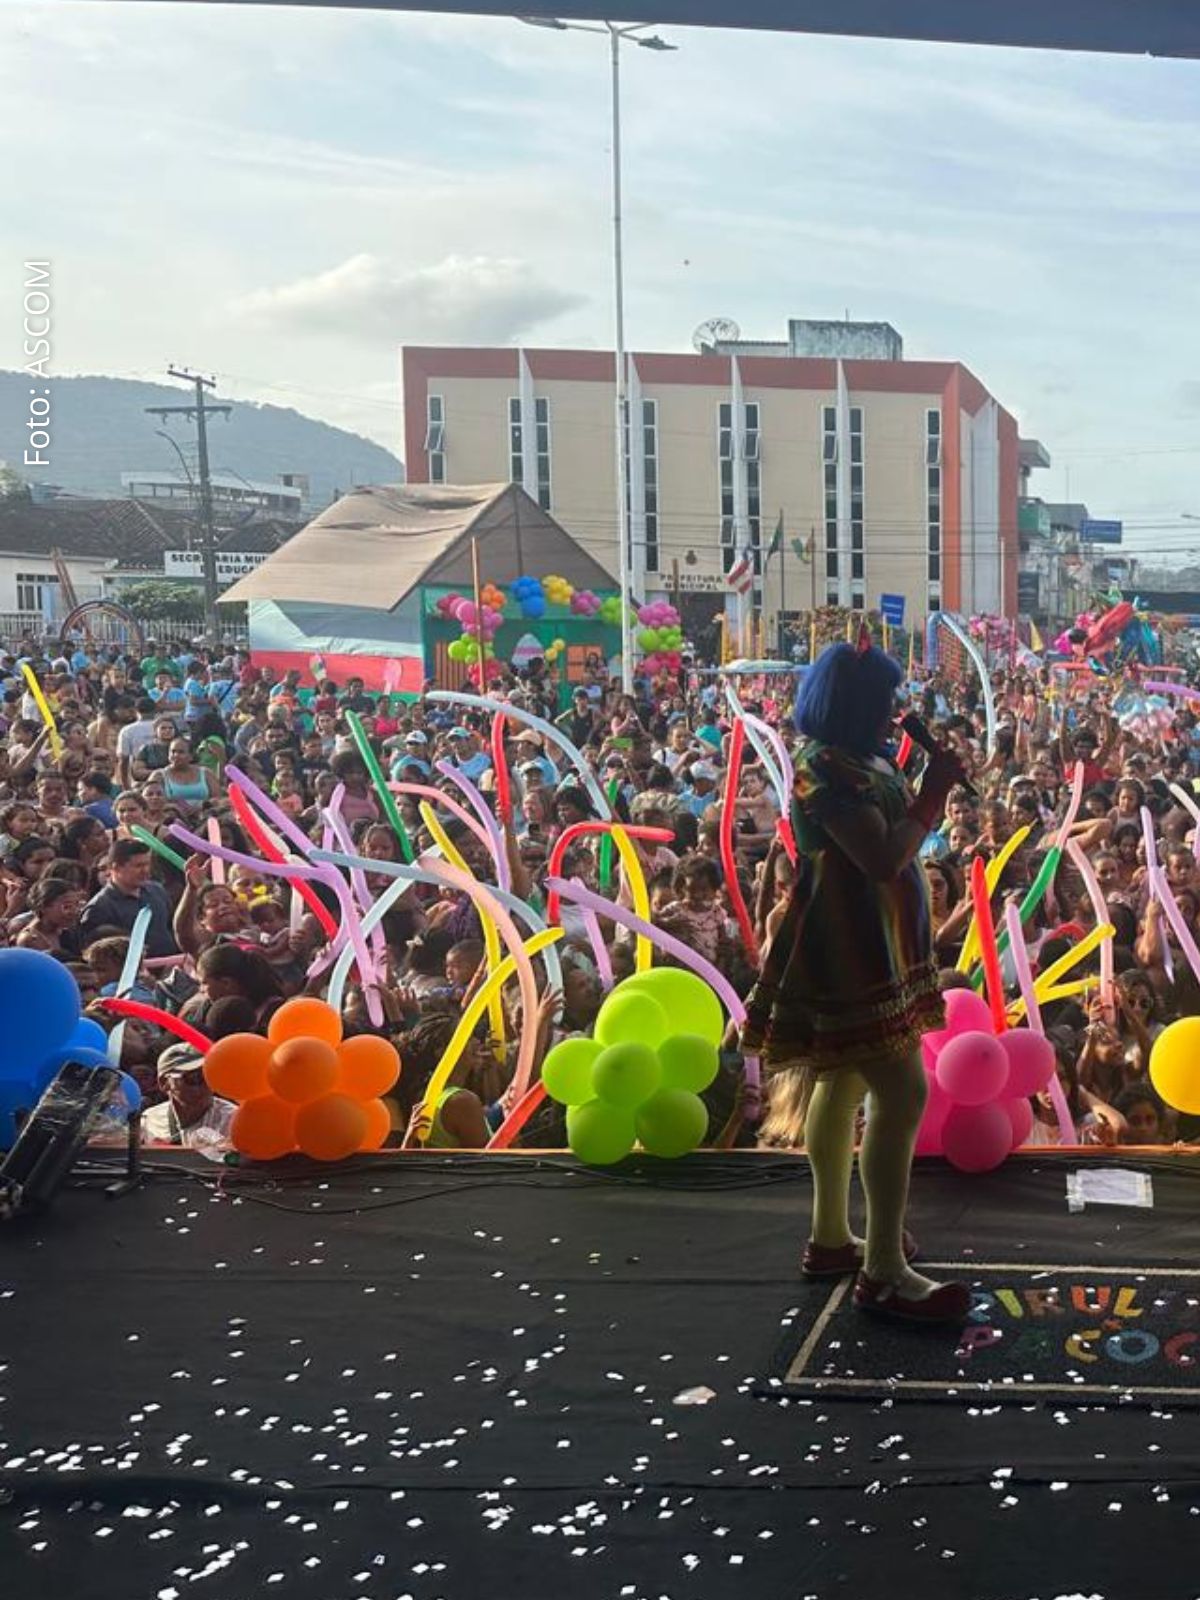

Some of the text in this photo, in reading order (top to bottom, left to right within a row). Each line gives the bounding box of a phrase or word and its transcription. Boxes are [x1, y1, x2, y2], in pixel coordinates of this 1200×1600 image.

[171, 553, 241, 562] SECRARIA
[659, 574, 723, 583] PRFEITURA
[664, 582, 718, 590] MNICIPAL
